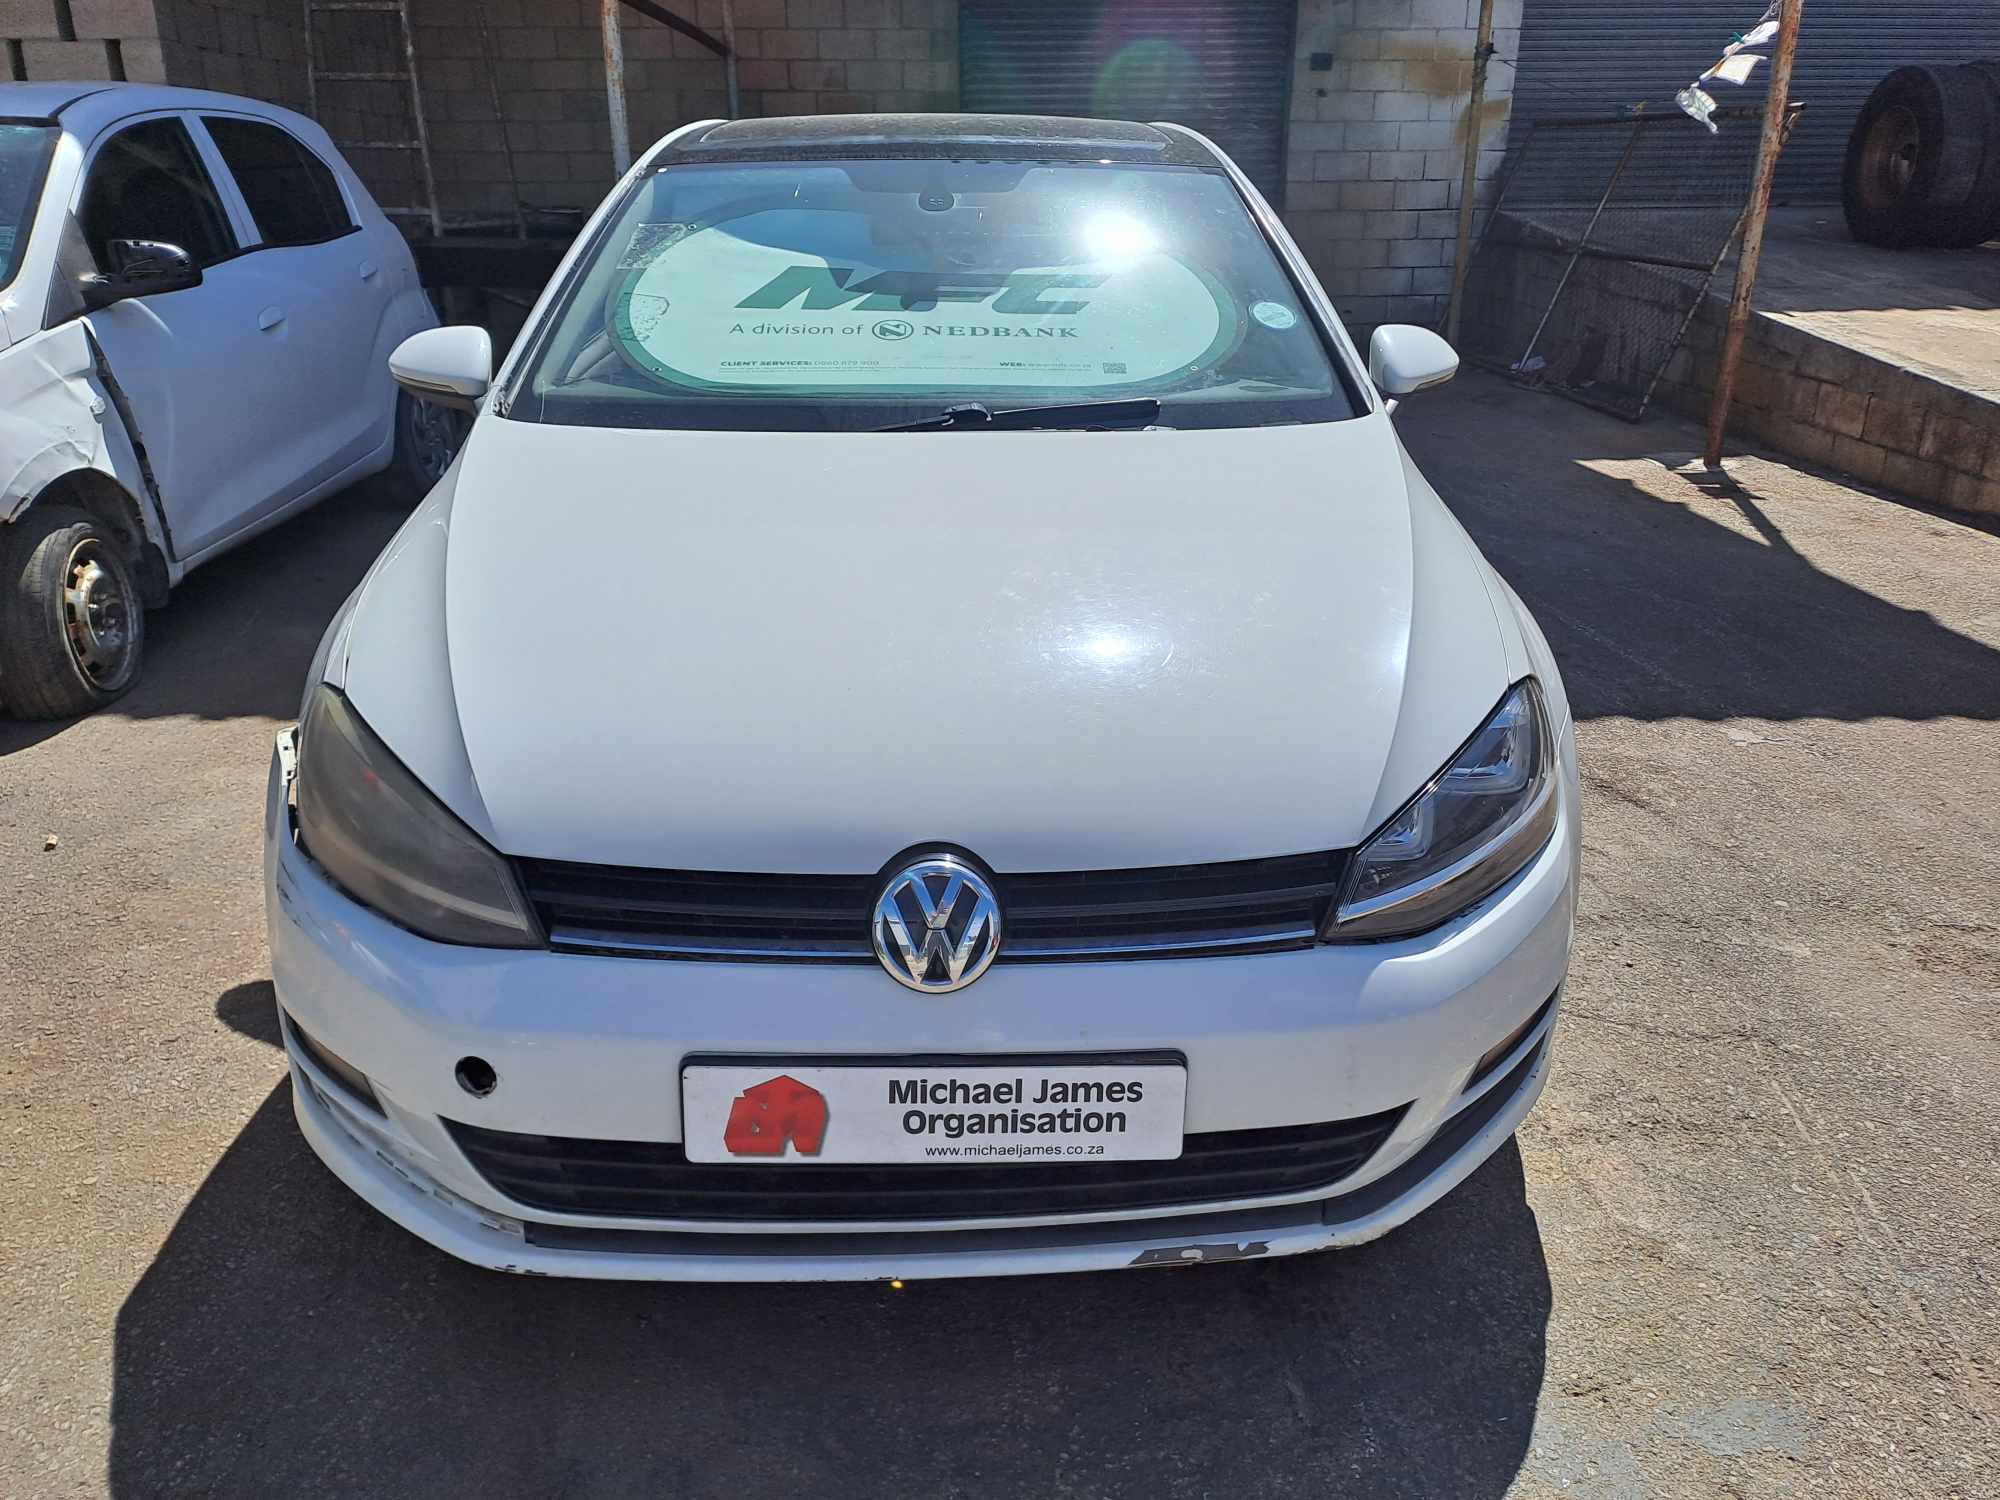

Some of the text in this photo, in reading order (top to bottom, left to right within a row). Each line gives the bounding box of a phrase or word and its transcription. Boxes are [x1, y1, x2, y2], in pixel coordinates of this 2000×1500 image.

[734, 265, 1113, 315] MFC
[729, 323, 745, 335] A
[752, 322, 834, 336] division
[841, 322, 865, 336] of
[922, 325, 1079, 338] NEDBANK
[888, 1078, 1143, 1105] Michael James
[902, 1107, 1127, 1139] Organisation
[925, 1143, 1105, 1158] www.michaeljames.co.za
